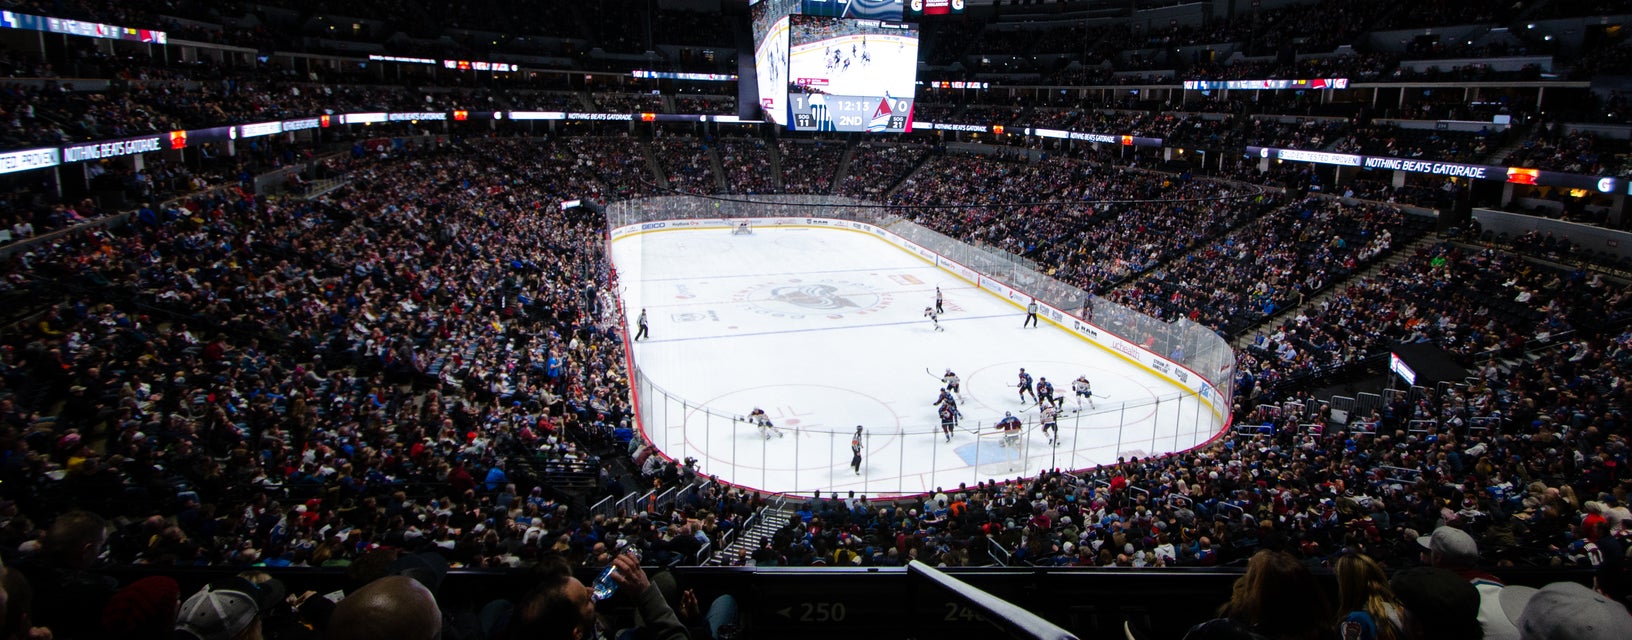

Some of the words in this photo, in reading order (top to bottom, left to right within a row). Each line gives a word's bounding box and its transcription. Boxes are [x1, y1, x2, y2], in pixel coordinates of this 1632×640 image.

[796, 97, 803, 110] 1
[838, 101, 870, 112] 12:13
[897, 100, 908, 112] 0
[839, 116, 863, 126] 2ND
[64, 144, 101, 163] NOTHING
[101, 141, 125, 158] BEATS
[1365, 157, 1401, 170] NOTHING
[1401, 159, 1431, 173] BEATS
[1597, 177, 1613, 193] G
[641, 222, 666, 230] GEICO
[1080, 325, 1098, 337] RAM
[800, 602, 846, 622] 250
